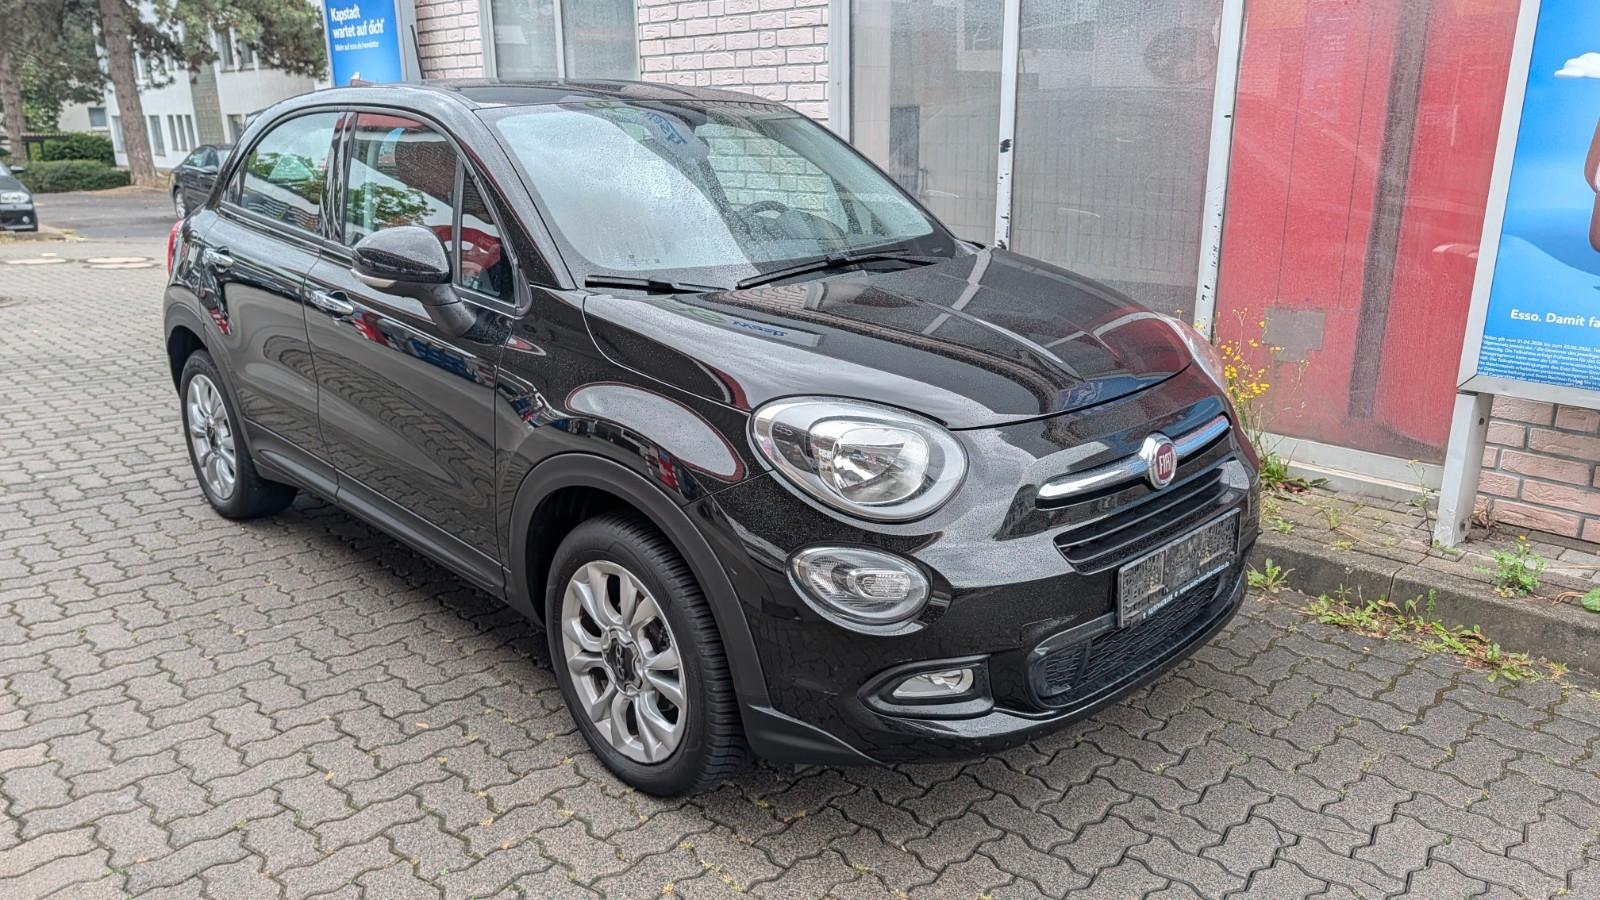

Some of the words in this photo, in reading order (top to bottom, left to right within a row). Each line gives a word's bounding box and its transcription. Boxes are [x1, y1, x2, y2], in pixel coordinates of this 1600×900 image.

[330, 4, 360, 24] Kapstadt
[333, 24, 356, 39] wartet
[357, 20, 368, 37] auf
[1510, 309, 1542, 322] Esso.
[1546, 312, 1585, 327] Damit
[1158, 451, 1171, 476] FIAT
